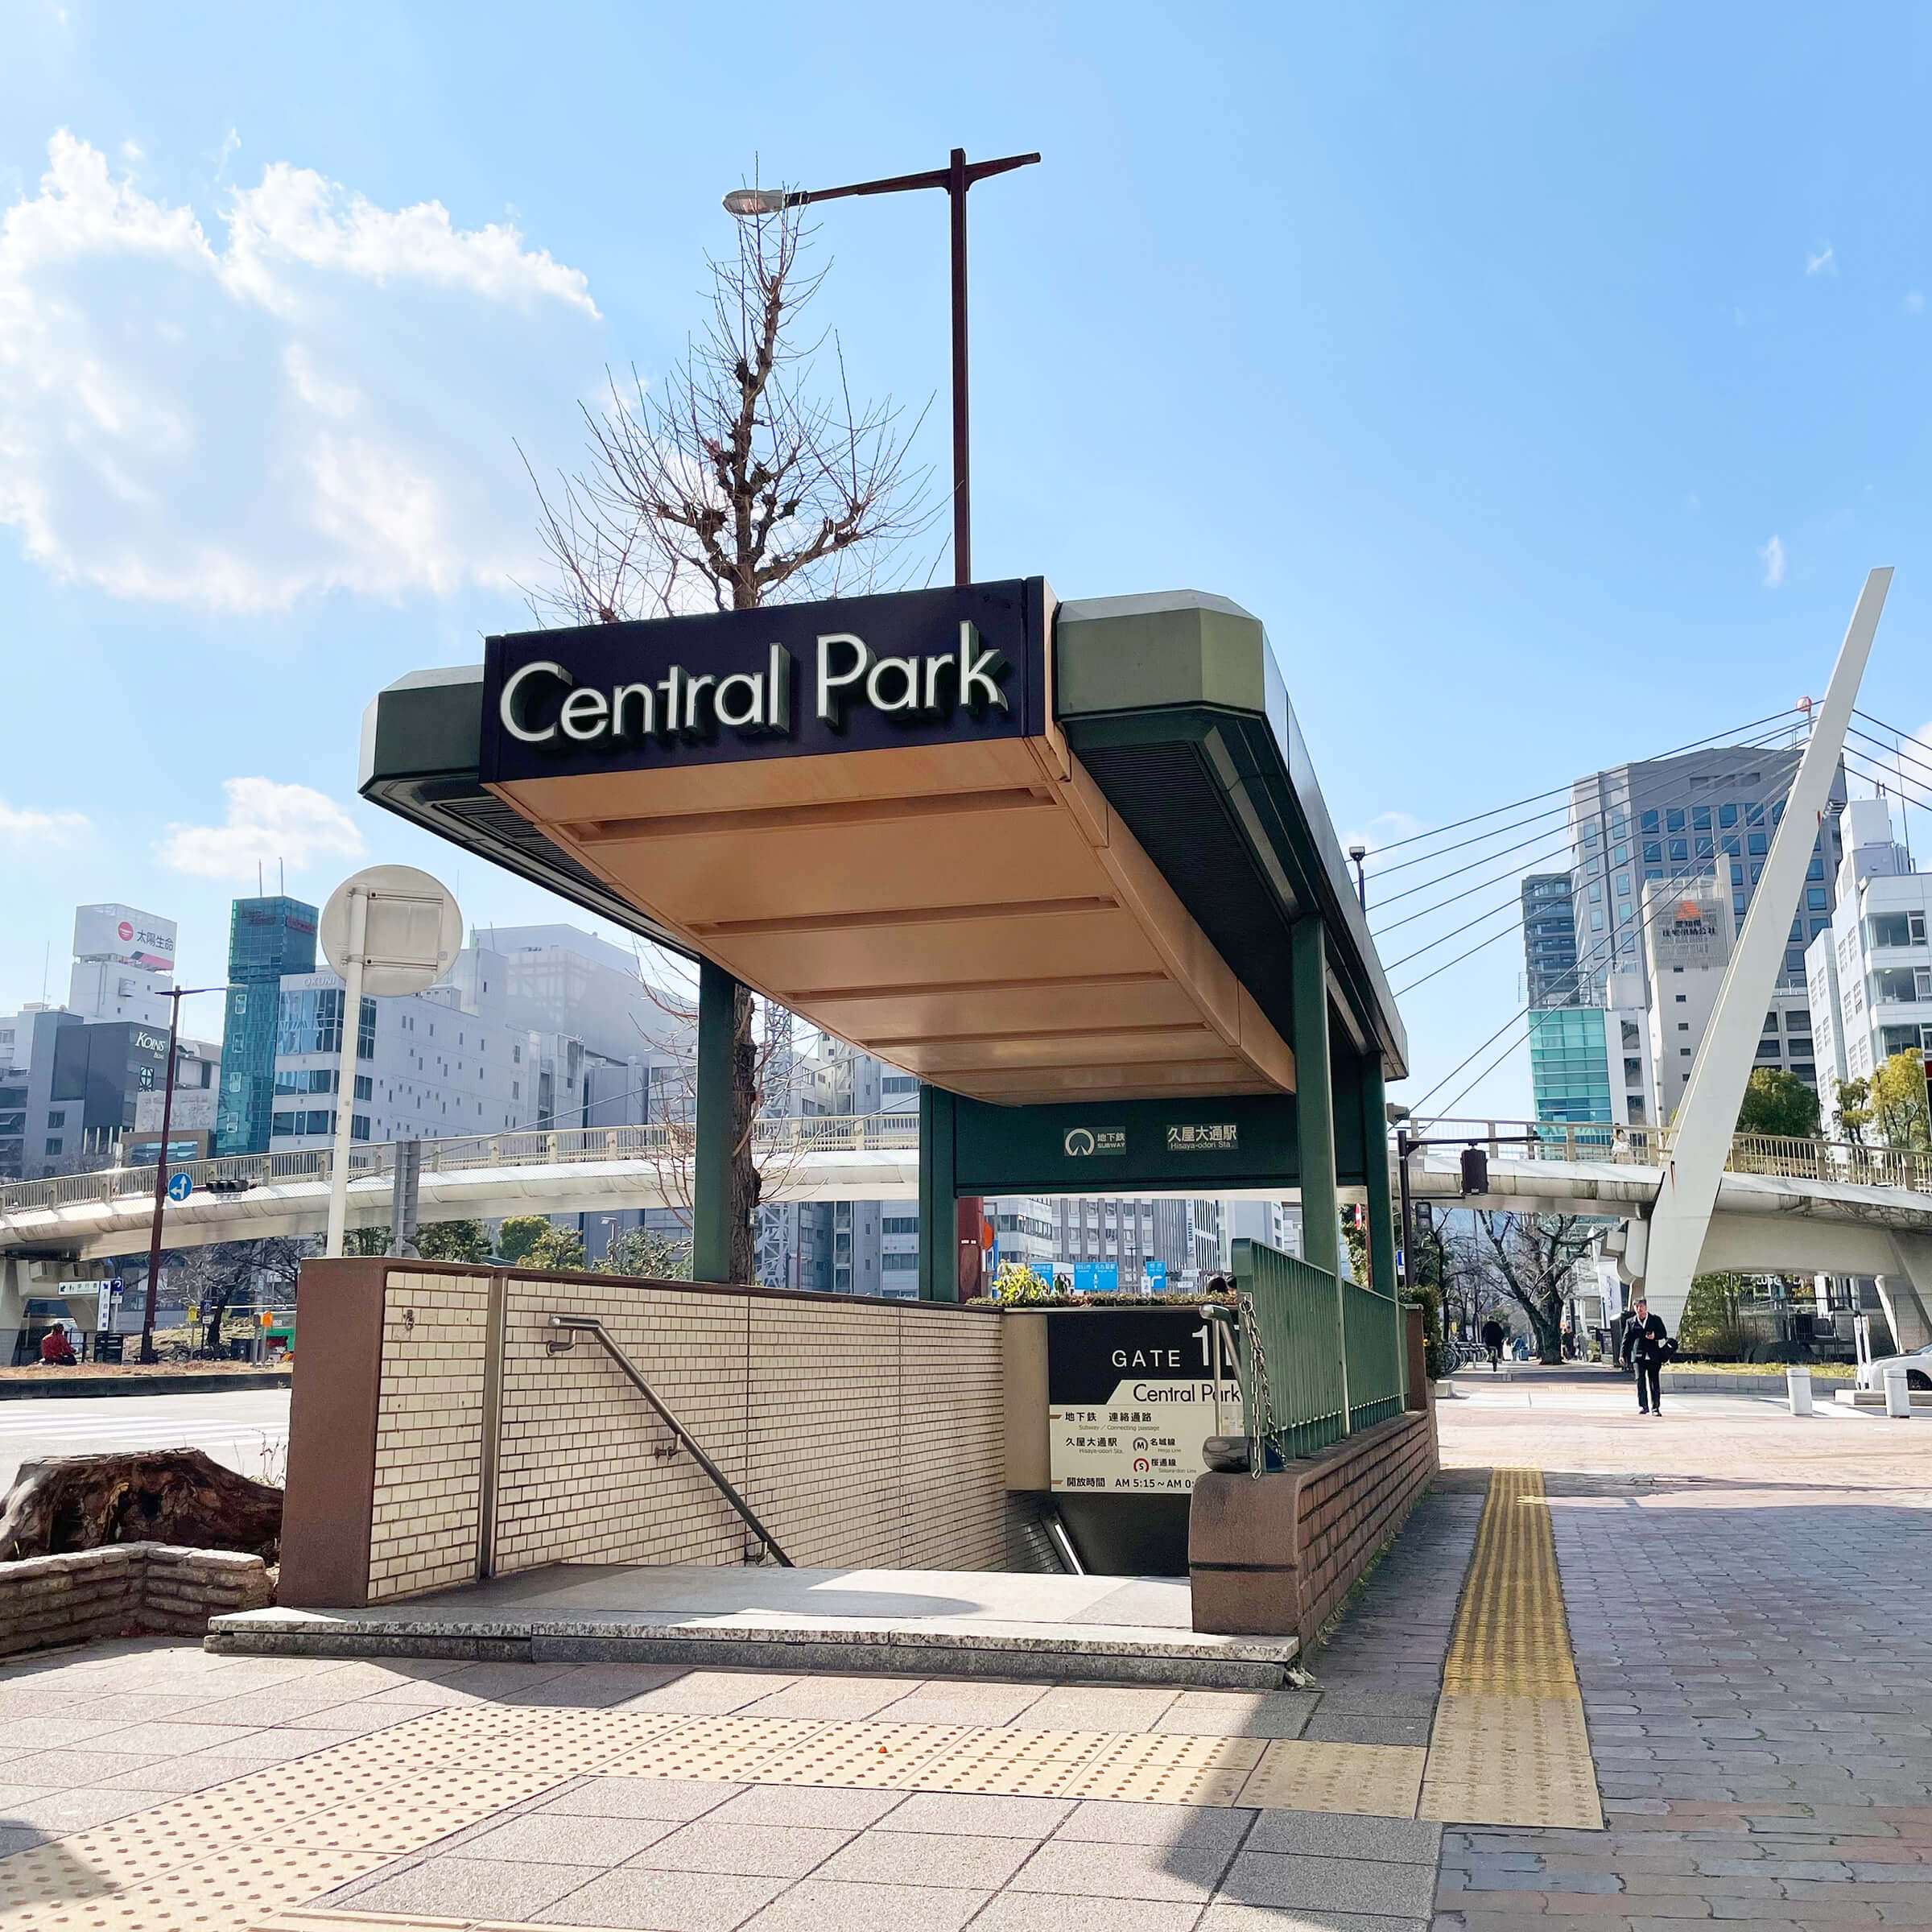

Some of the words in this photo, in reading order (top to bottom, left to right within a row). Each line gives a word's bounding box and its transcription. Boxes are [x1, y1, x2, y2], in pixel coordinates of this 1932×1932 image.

[500, 642, 787, 742] Central
[816, 620, 1004, 720] Park
[137, 930, 174, 952] 太陽生命
[1096, 1133, 1125, 1141] 地下鉄
[1167, 1125, 1236, 1142] 久屋大通駅
[1170, 1141, 1216, 1151] Hisaya-odori
[1112, 1349, 1181, 1368] GATE
[1133, 1383, 1195, 1402] Central
[1065, 1412, 1097, 1422] 地下鉄
[1108, 1412, 1152, 1422] 連絡通路
[1065, 1437, 1117, 1447] 久屋大通駅
[1067, 1477, 1105, 1488] 開放時間
[1115, 1478, 1130, 1488] AM
[1133, 1478, 1155, 1488] 5:15
[1166, 1479, 1182, 1488] AM
